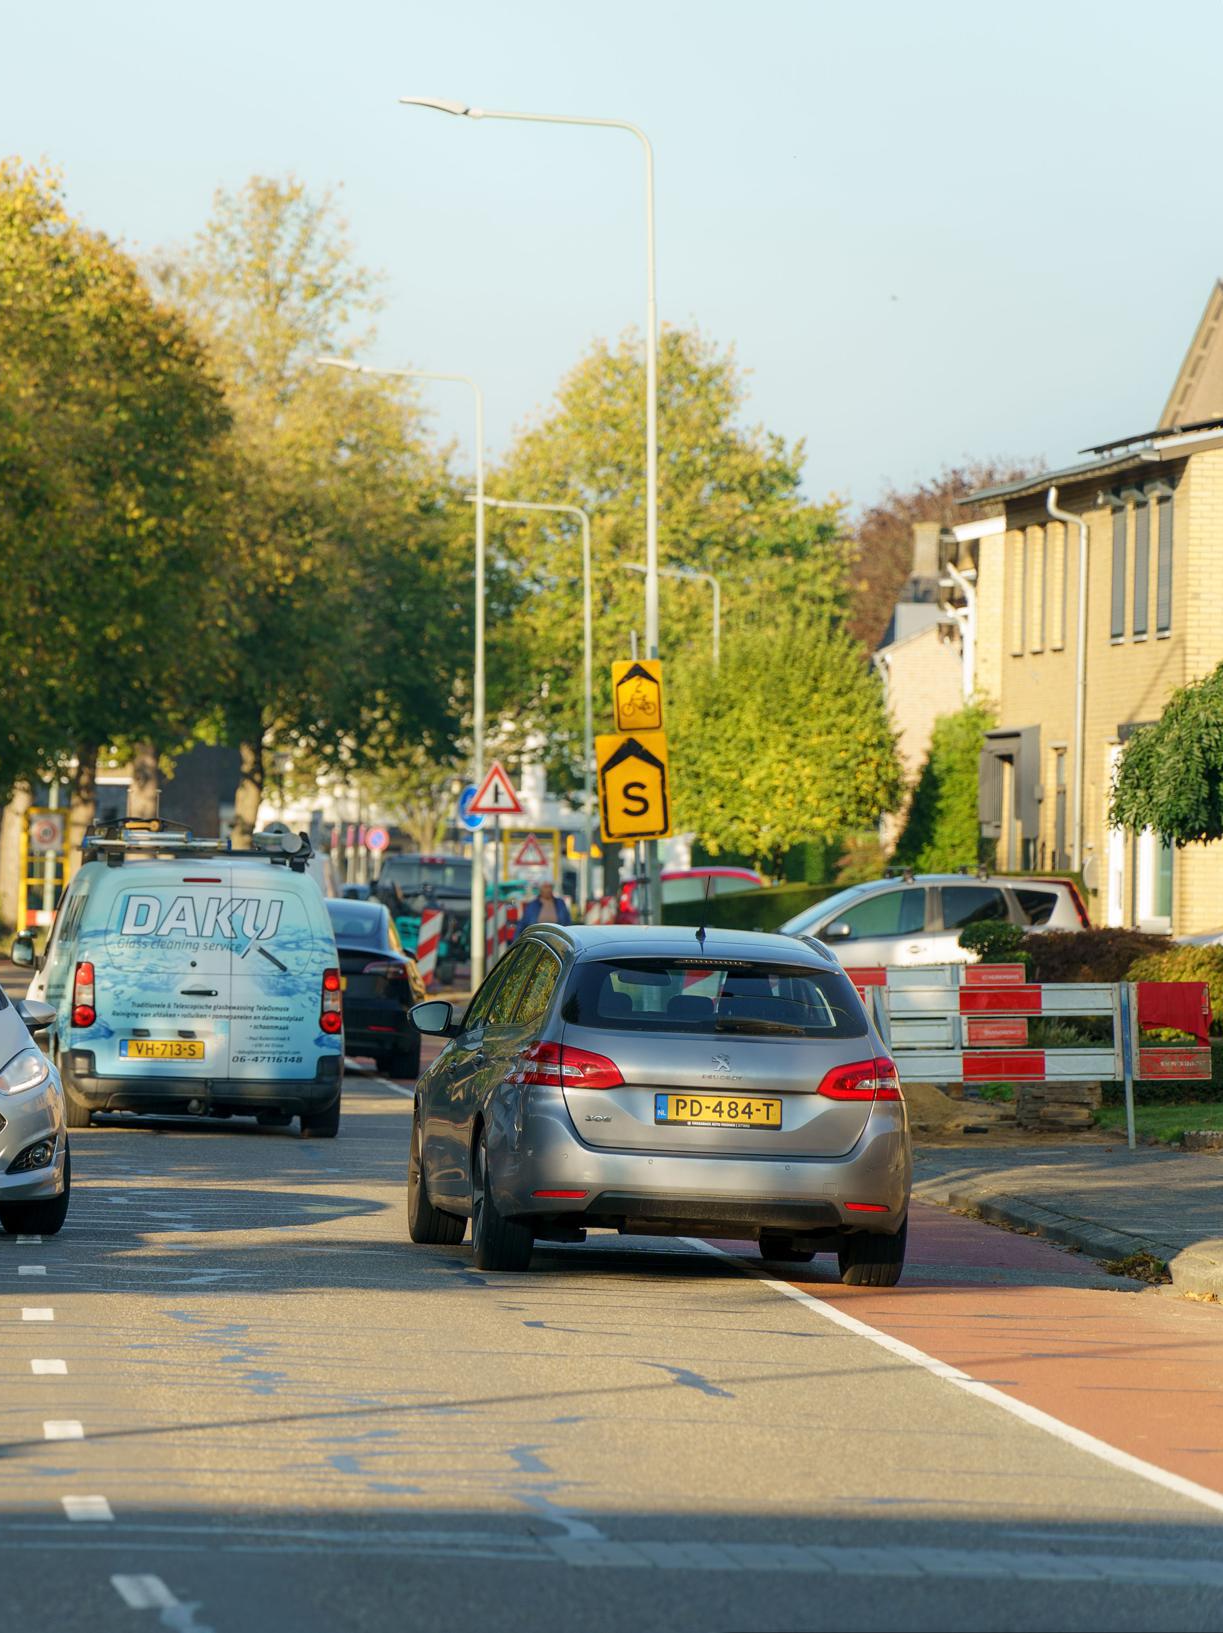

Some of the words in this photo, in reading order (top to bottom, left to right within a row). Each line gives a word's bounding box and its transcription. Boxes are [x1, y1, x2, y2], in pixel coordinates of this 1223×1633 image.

[622, 781, 649, 817] S
[120, 895, 284, 941] DAKU
[117, 938, 148, 950] Glass
[151, 938, 200, 954] cleaning
[203, 940, 243, 952] service
[136, 1042, 196, 1057] VH-713-S
[232, 1055, 303, 1063] 06-47116148
[675, 1098, 775, 1121] PD-484-T
